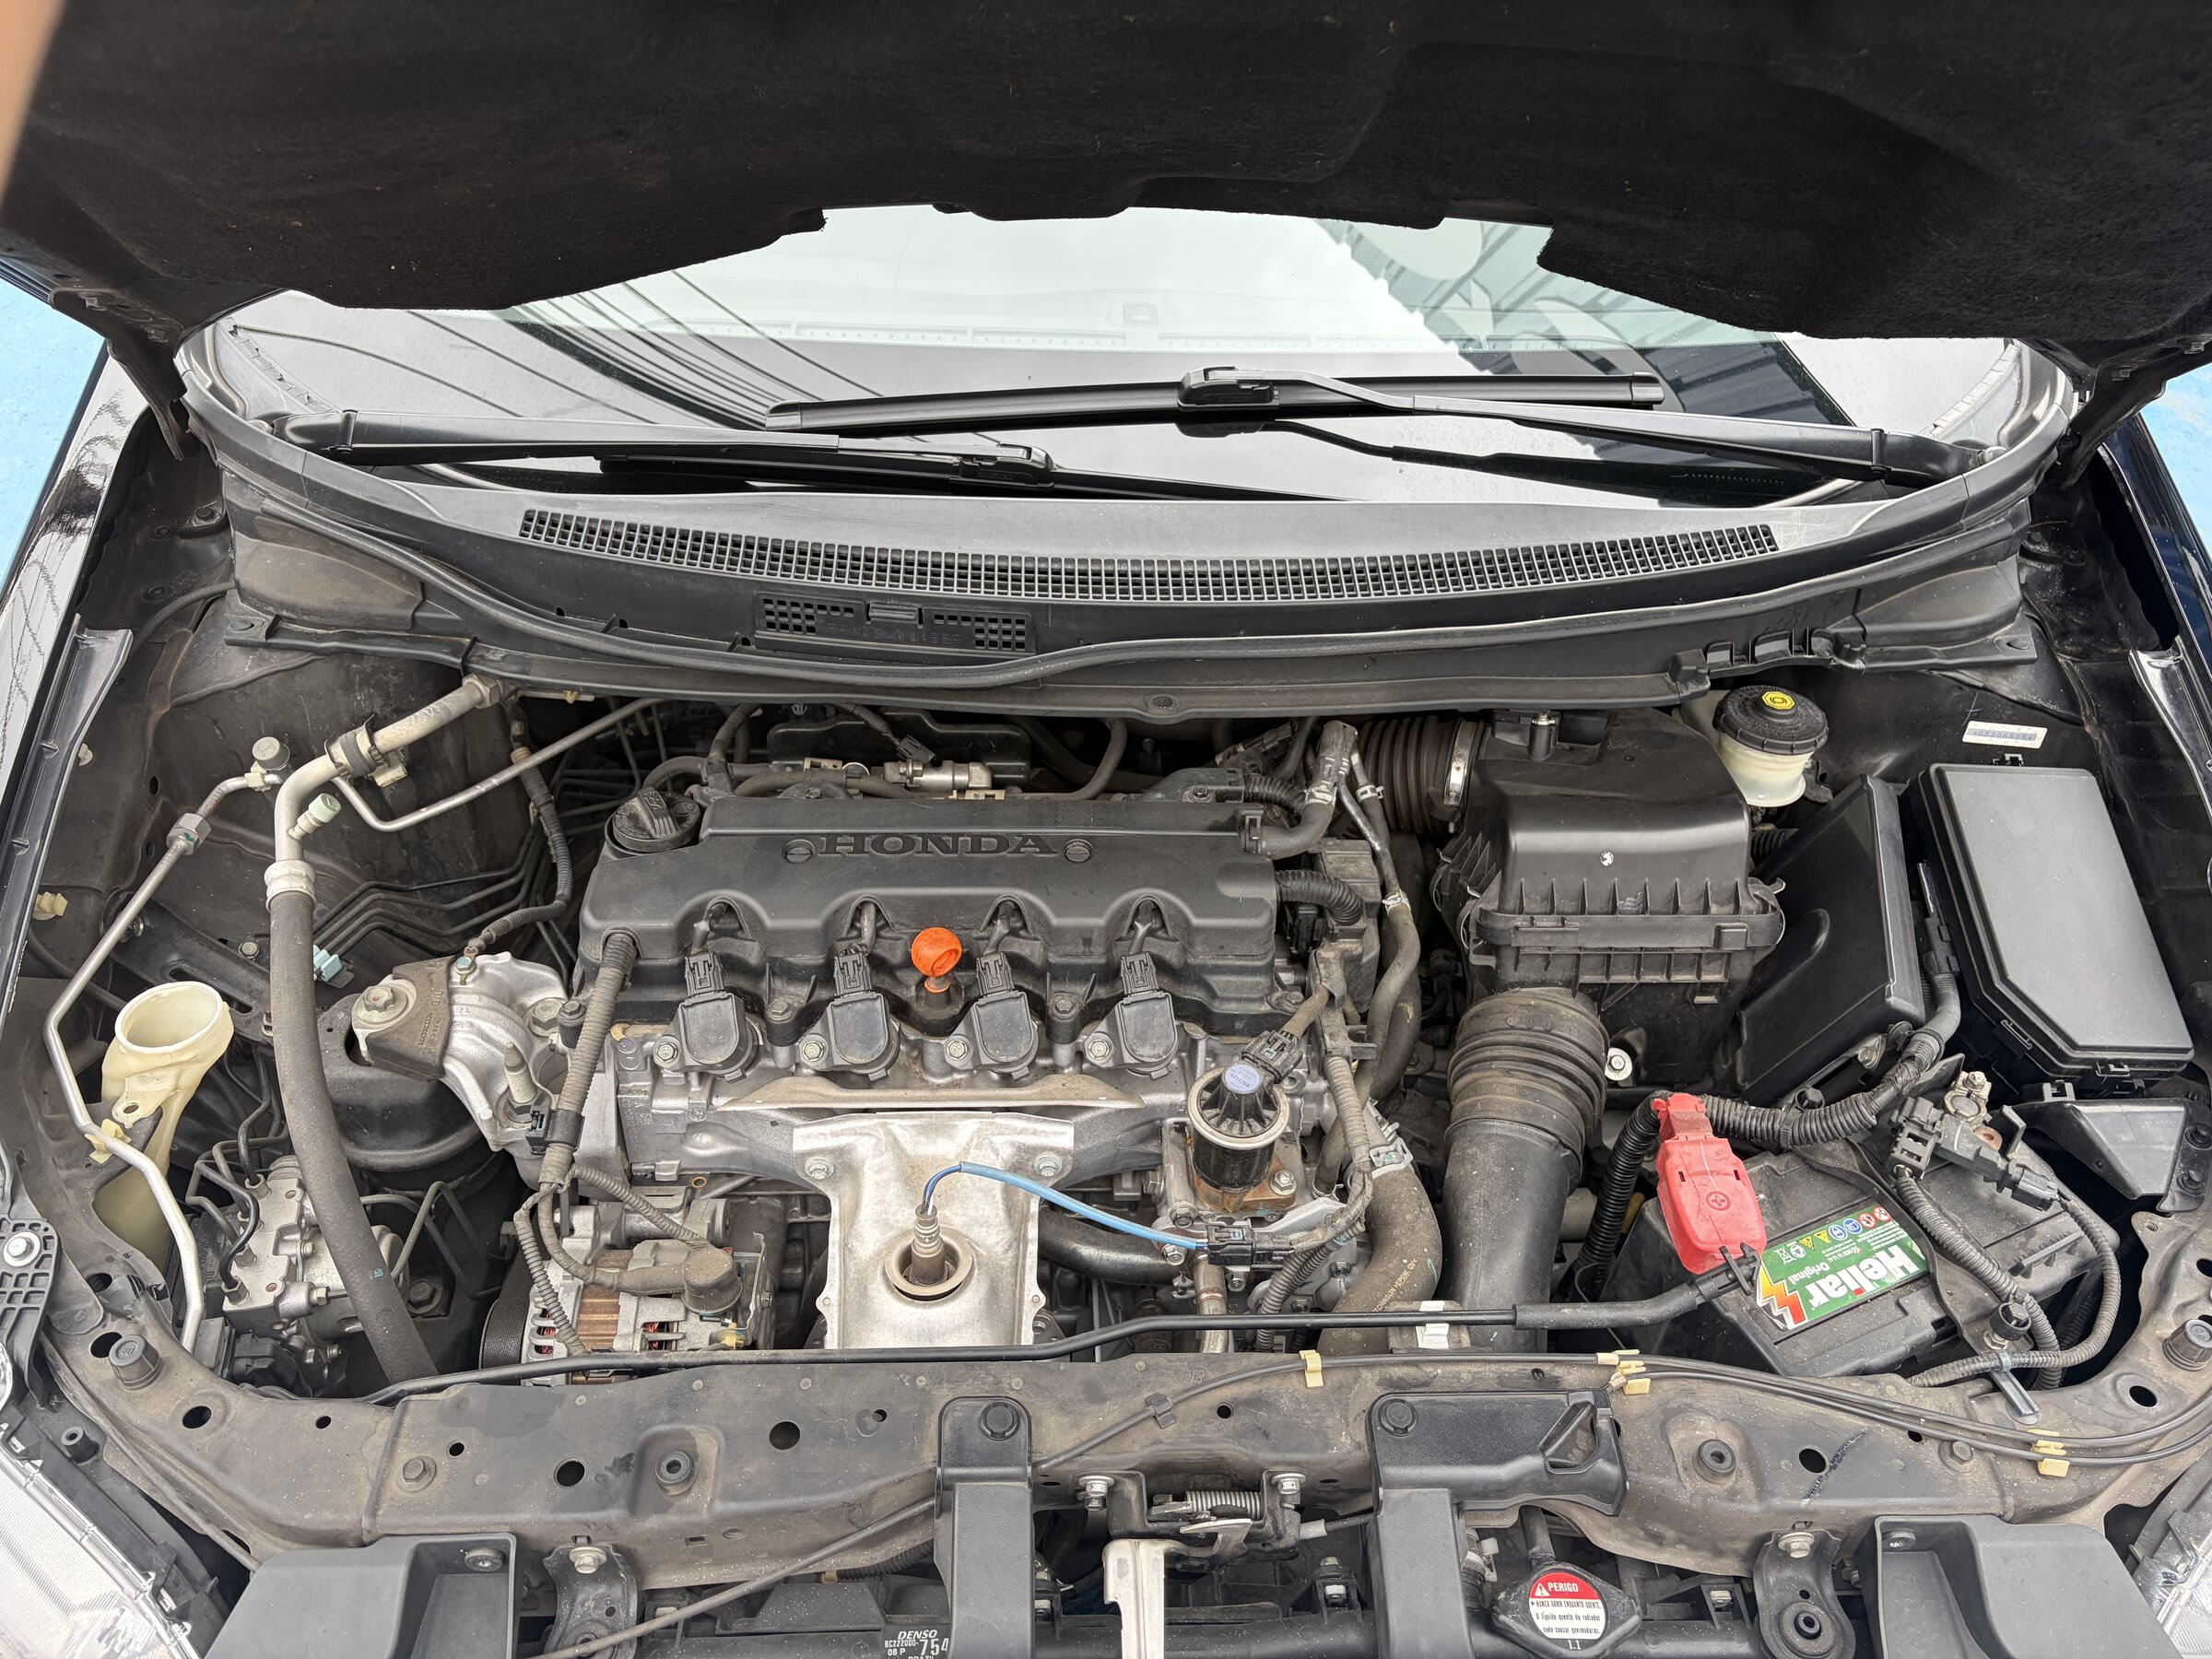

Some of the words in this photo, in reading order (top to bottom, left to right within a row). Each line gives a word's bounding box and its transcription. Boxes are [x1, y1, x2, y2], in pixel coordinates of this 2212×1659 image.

[818, 833, 1059, 857] HONDA
[1788, 1261, 1830, 1285] Original
[1806, 1244, 1920, 1308] Heliar
[1547, 1582, 1579, 1593] PERIGO
[897, 1630, 938, 1640] DENSO
[1568, 1640, 1582, 1650] 1.1
